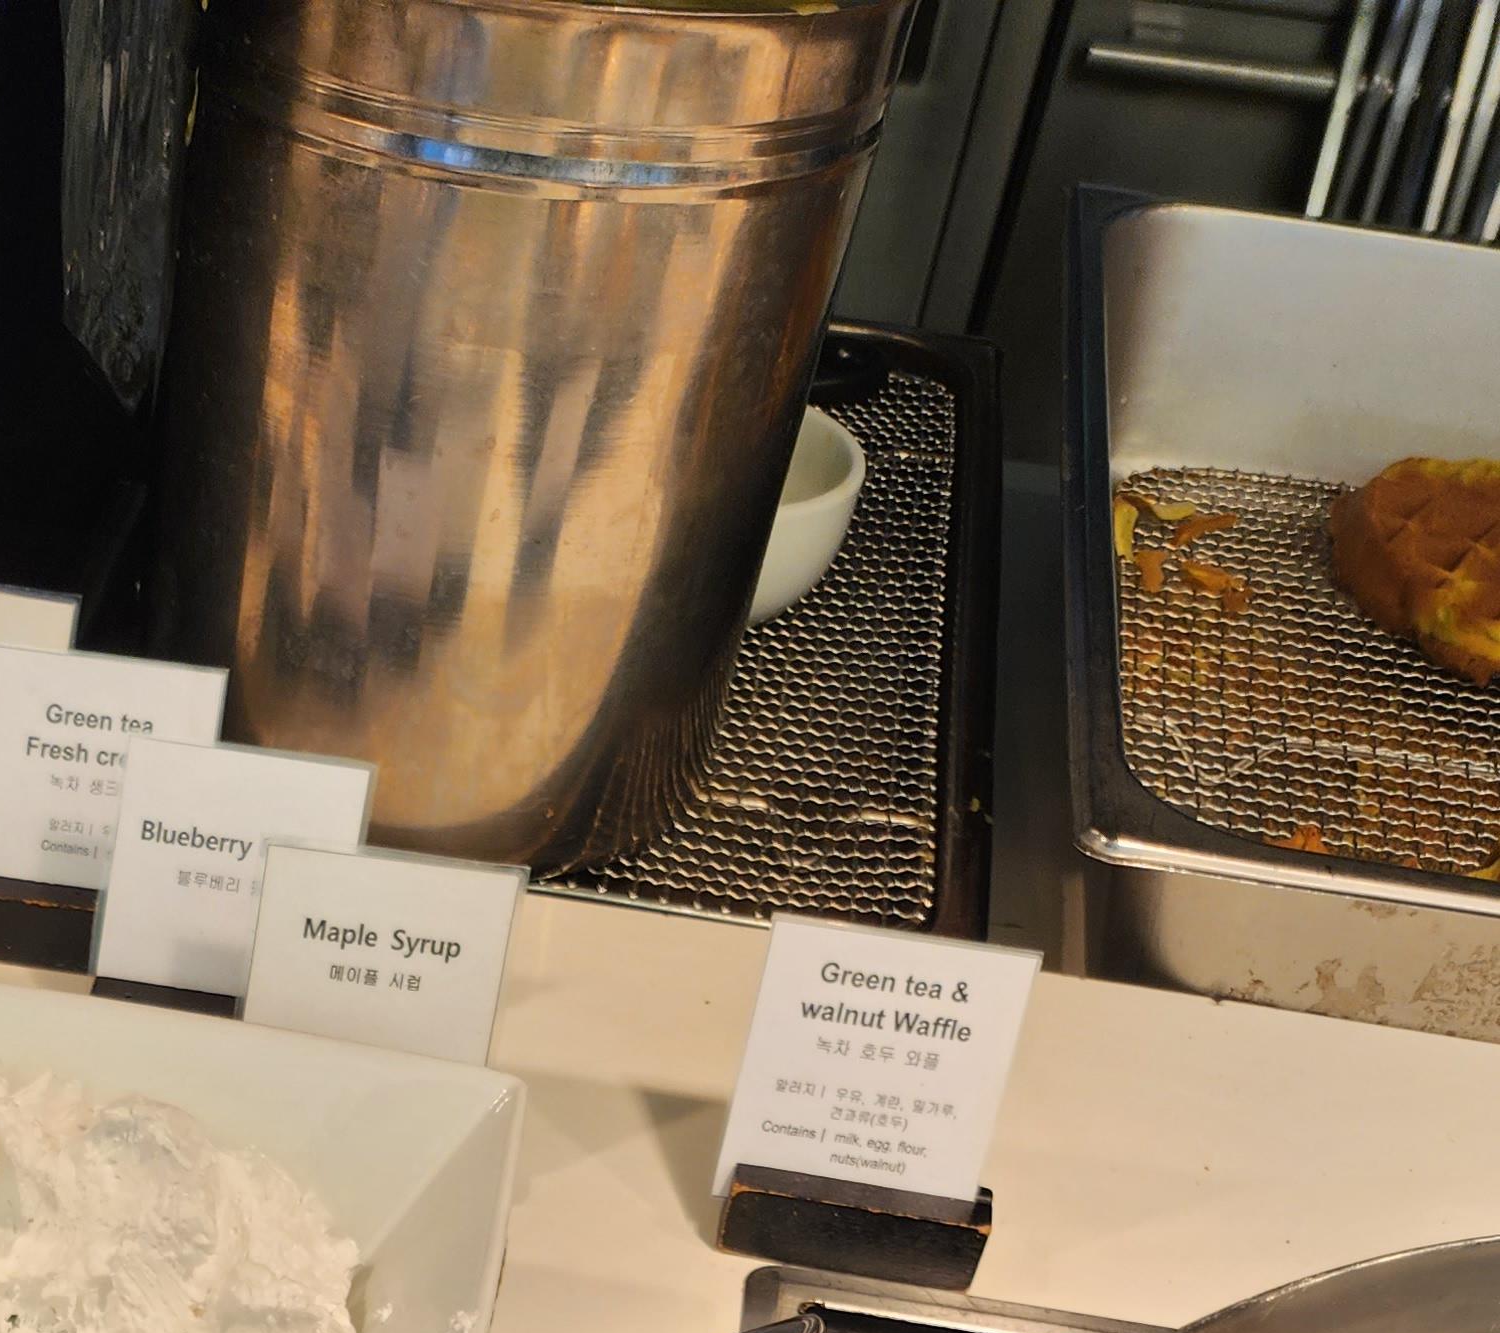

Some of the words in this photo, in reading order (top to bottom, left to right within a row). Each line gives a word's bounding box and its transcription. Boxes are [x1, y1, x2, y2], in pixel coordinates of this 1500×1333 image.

[46, 704, 112, 730] Green
[121, 714, 153, 733] tea
[26, 736, 88, 763] Fresh
[41, 839, 89, 857] Contains
[141, 820, 252, 861] Blueberry
[177, 870, 240, 894] 블루베리
[303, 917, 378, 950] Maple
[390, 929, 461, 964] Syrup
[329, 964, 379, 987] 메이플
[388, 972, 422, 992] 시럽
[821, 962, 895, 993] Green
[906, 975, 942, 1000] tea
[951, 981, 969, 1003] &
[801, 1001, 885, 1030] walnut
[893, 1009, 972, 1042] Waffle
[817, 1035, 849, 1056] 녹차
[859, 1042, 895, 1063] 호두
[904, 1049, 939, 1071] 와플
[761, 1119, 817, 1140] Contains
[829, 1151, 907, 1176] nuts(walnut)
